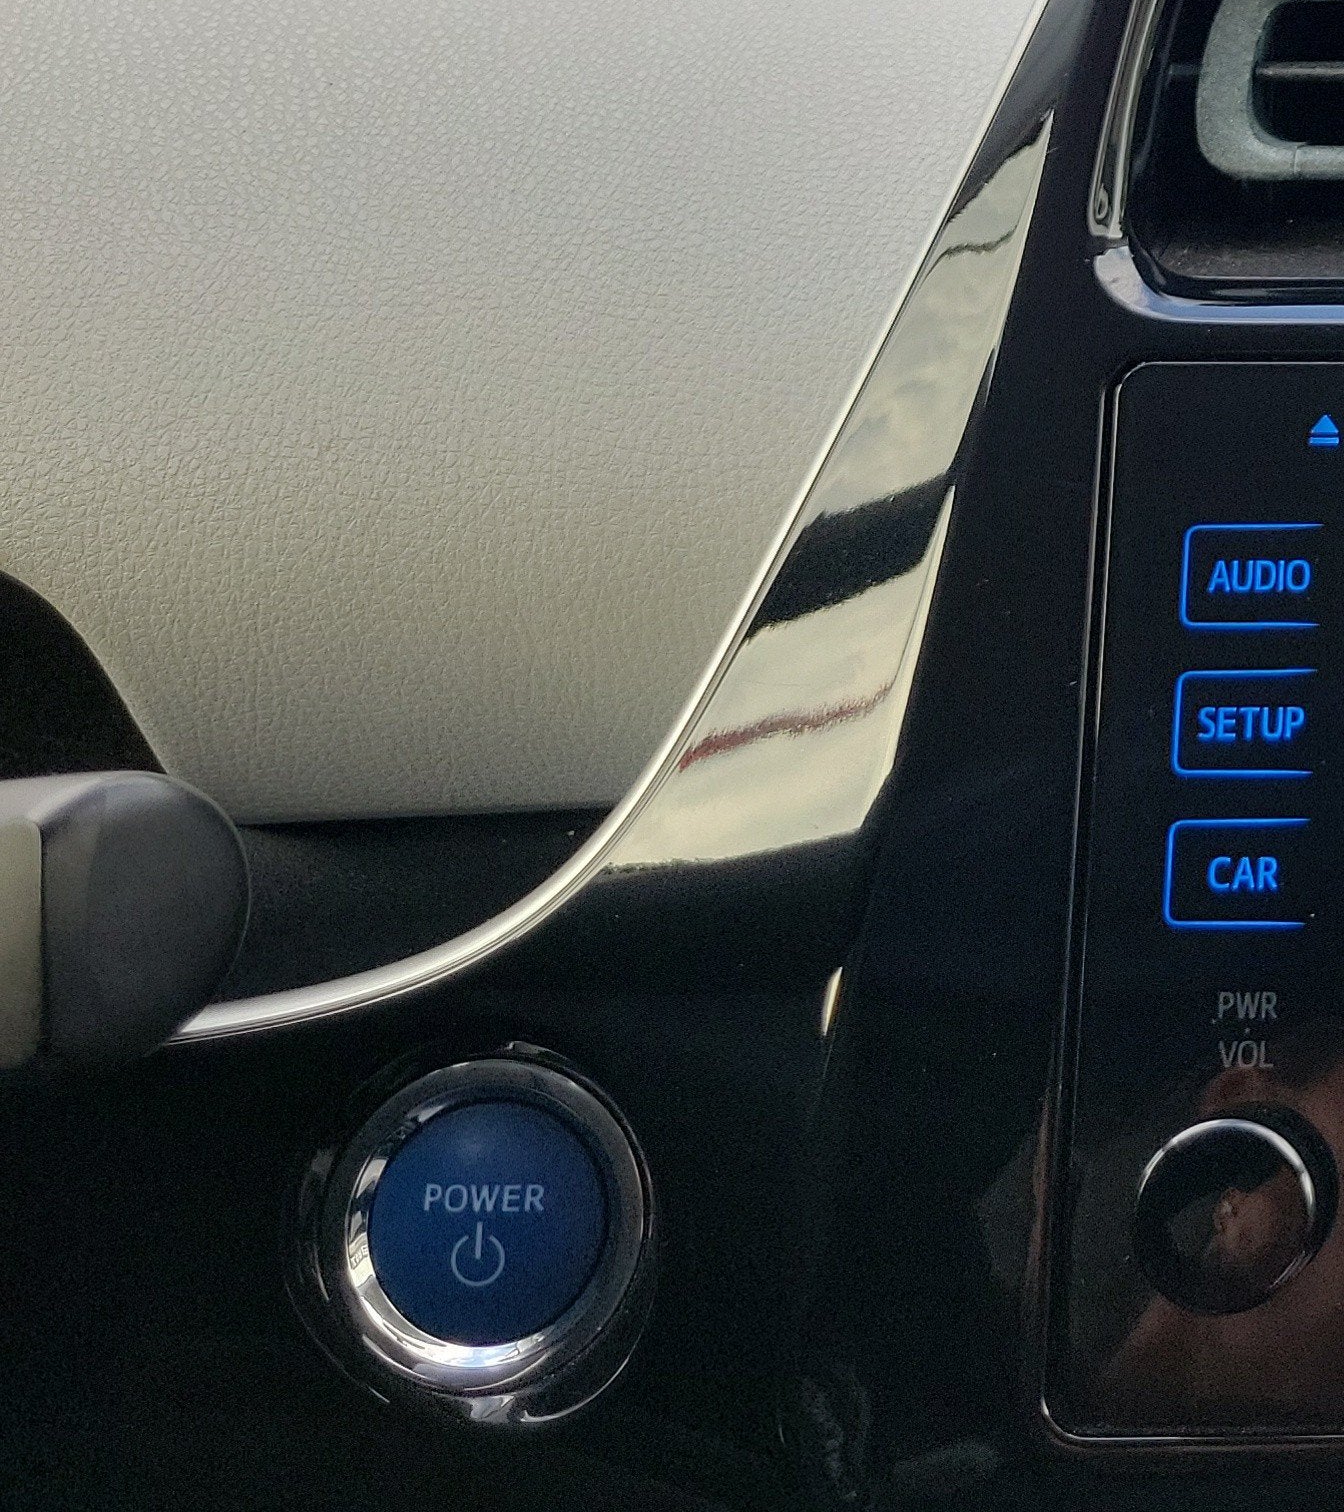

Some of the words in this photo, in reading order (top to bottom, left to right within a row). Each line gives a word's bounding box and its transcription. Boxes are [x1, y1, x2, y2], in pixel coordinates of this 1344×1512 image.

[1208, 559, 1311, 594] AUDIO
[1198, 706, 1305, 741] SETUP
[1208, 855, 1278, 891] CAR
[1217, 991, 1277, 1019] PWR
[1217, 1040, 1274, 1068] VOL
[423, 1183, 545, 1212] POWER
